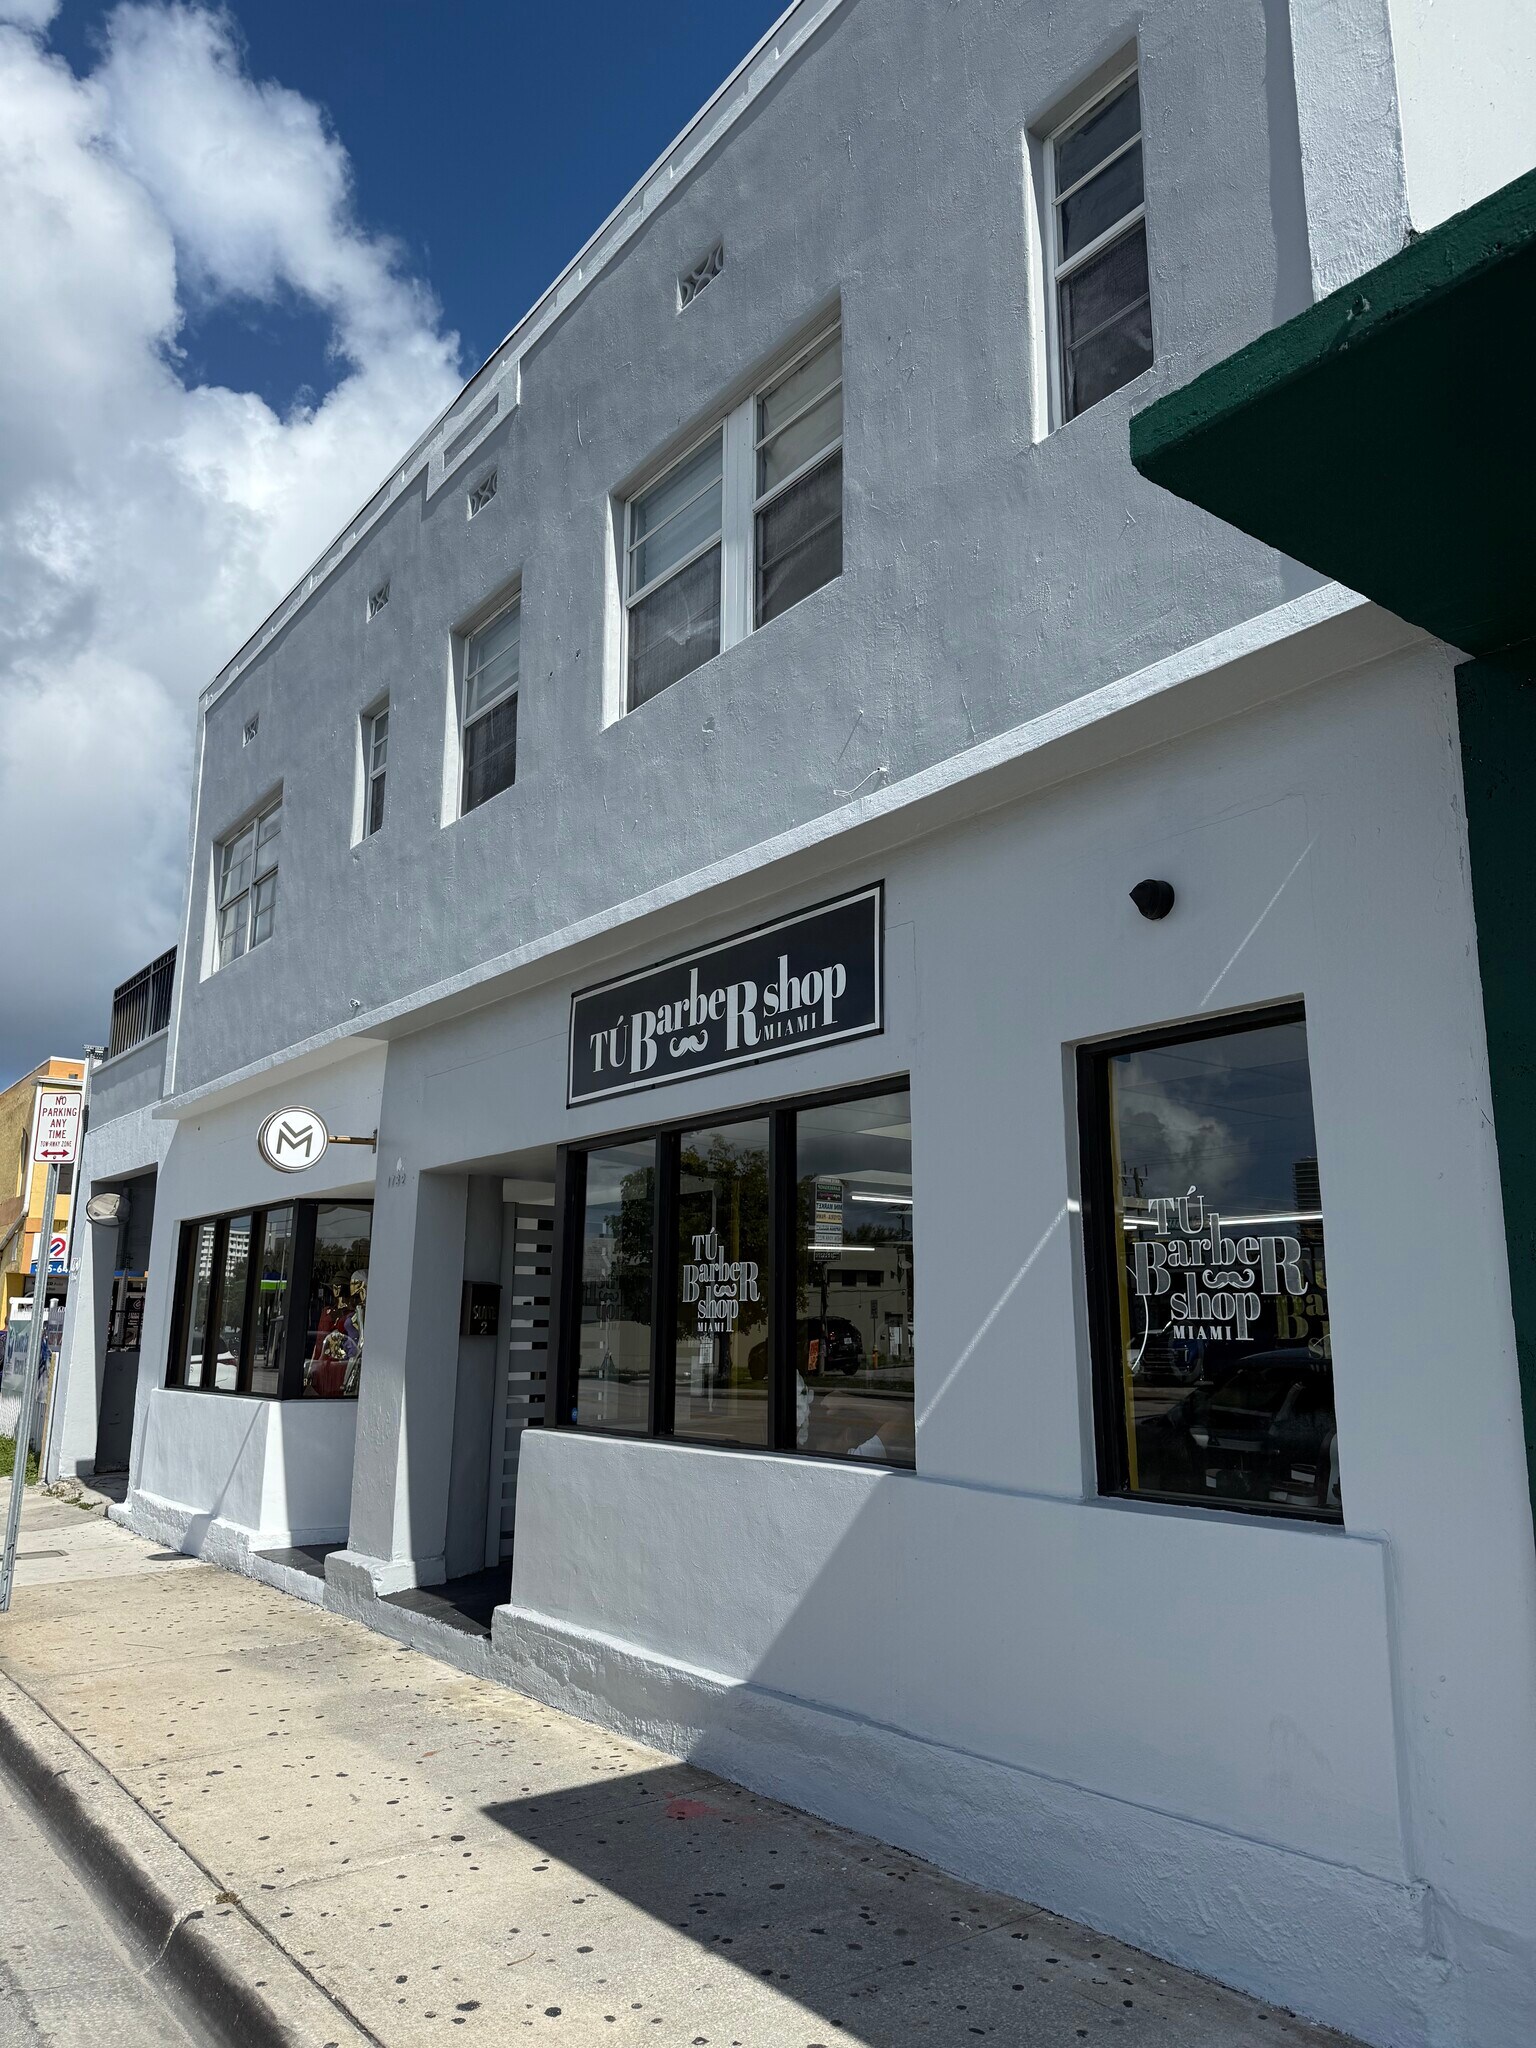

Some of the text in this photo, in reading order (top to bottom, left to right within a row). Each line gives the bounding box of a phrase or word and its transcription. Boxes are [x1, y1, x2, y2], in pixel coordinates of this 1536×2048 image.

[590, 1015, 628, 1073] TÚ
[763, 954, 847, 1027] shop
[763, 1012, 816, 1041] MIAMI
[55, 1096, 67, 1106] NO
[42, 1107, 78, 1117] PARKING
[50, 1118, 67, 1128] ANY
[48, 1129, 67, 1139] TIME
[61, 1140, 72, 1148] ZONE
[1149, 1185, 1205, 1236] TÚ
[692, 1226, 718, 1261] TÚ
[697, 1287, 739, 1333] shop
[1170, 1272, 1261, 1341] shop
[480, 1321, 488, 1334] 2
[697, 1322, 725, 1333] MIAMI
[1173, 1325, 1232, 1341] MIAMI
